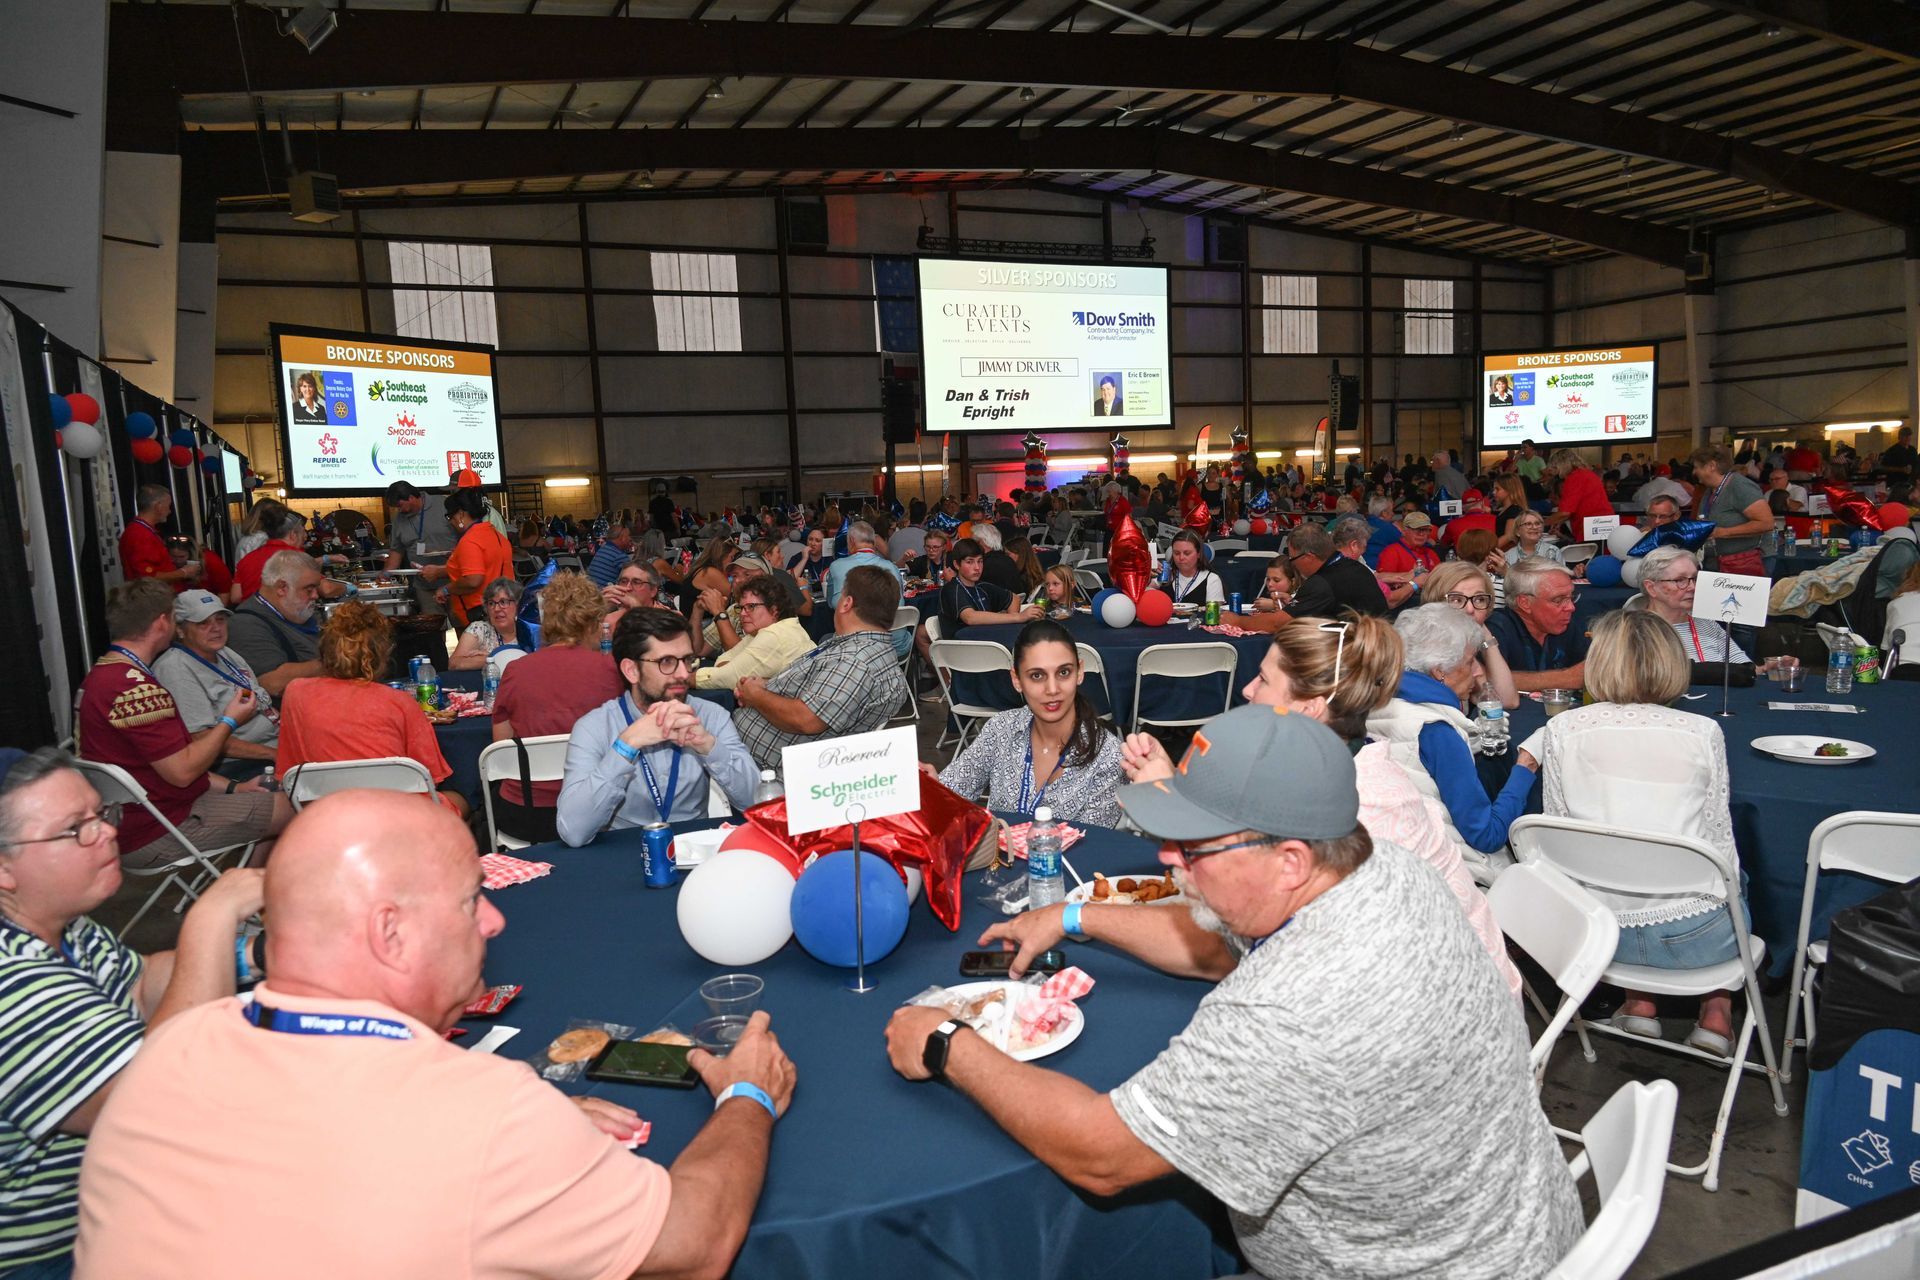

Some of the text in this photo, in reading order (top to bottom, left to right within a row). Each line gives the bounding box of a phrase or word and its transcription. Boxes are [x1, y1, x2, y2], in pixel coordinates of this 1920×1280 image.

[978, 267, 1118, 288] SILVER SPONSORS
[942, 303, 1021, 318] CURATED
[966, 318, 1031, 333] EVENTS
[1086, 312, 1155, 327] Dow Smith
[1087, 327, 1119, 335] Contracting
[326, 345, 455, 369] BRONZE SPONSORS
[1517, 351, 1622, 366] BRONZE SPONSORS
[978, 361, 1062, 376] JIMMY DRIVER
[1560, 373, 1594, 381] Southeast
[1560, 380, 1595, 388] Landscape
[385, 380, 426, 393] Southeast
[386, 391, 429, 406] Landscape
[447, 390, 488, 400] PROHIBITION
[945, 388, 1030, 402] Dan & Trish
[962, 405, 1015, 421] Epright
[387, 426, 426, 437] SMOOTHIE
[470, 451, 495, 460] ROGERS
[471, 460, 493, 469] GROUP
[1712, 576, 1756, 592] Reserved
[818, 741, 892, 769] Reserved
[810, 773, 898, 800] Schneider
[848, 787, 897, 803] Electric
[642, 843, 653, 876] pepsi
[300, 1015, 346, 1033] Wings
[347, 1018, 366, 1032] of
[1847, 1173, 1875, 1189] CHIPS
